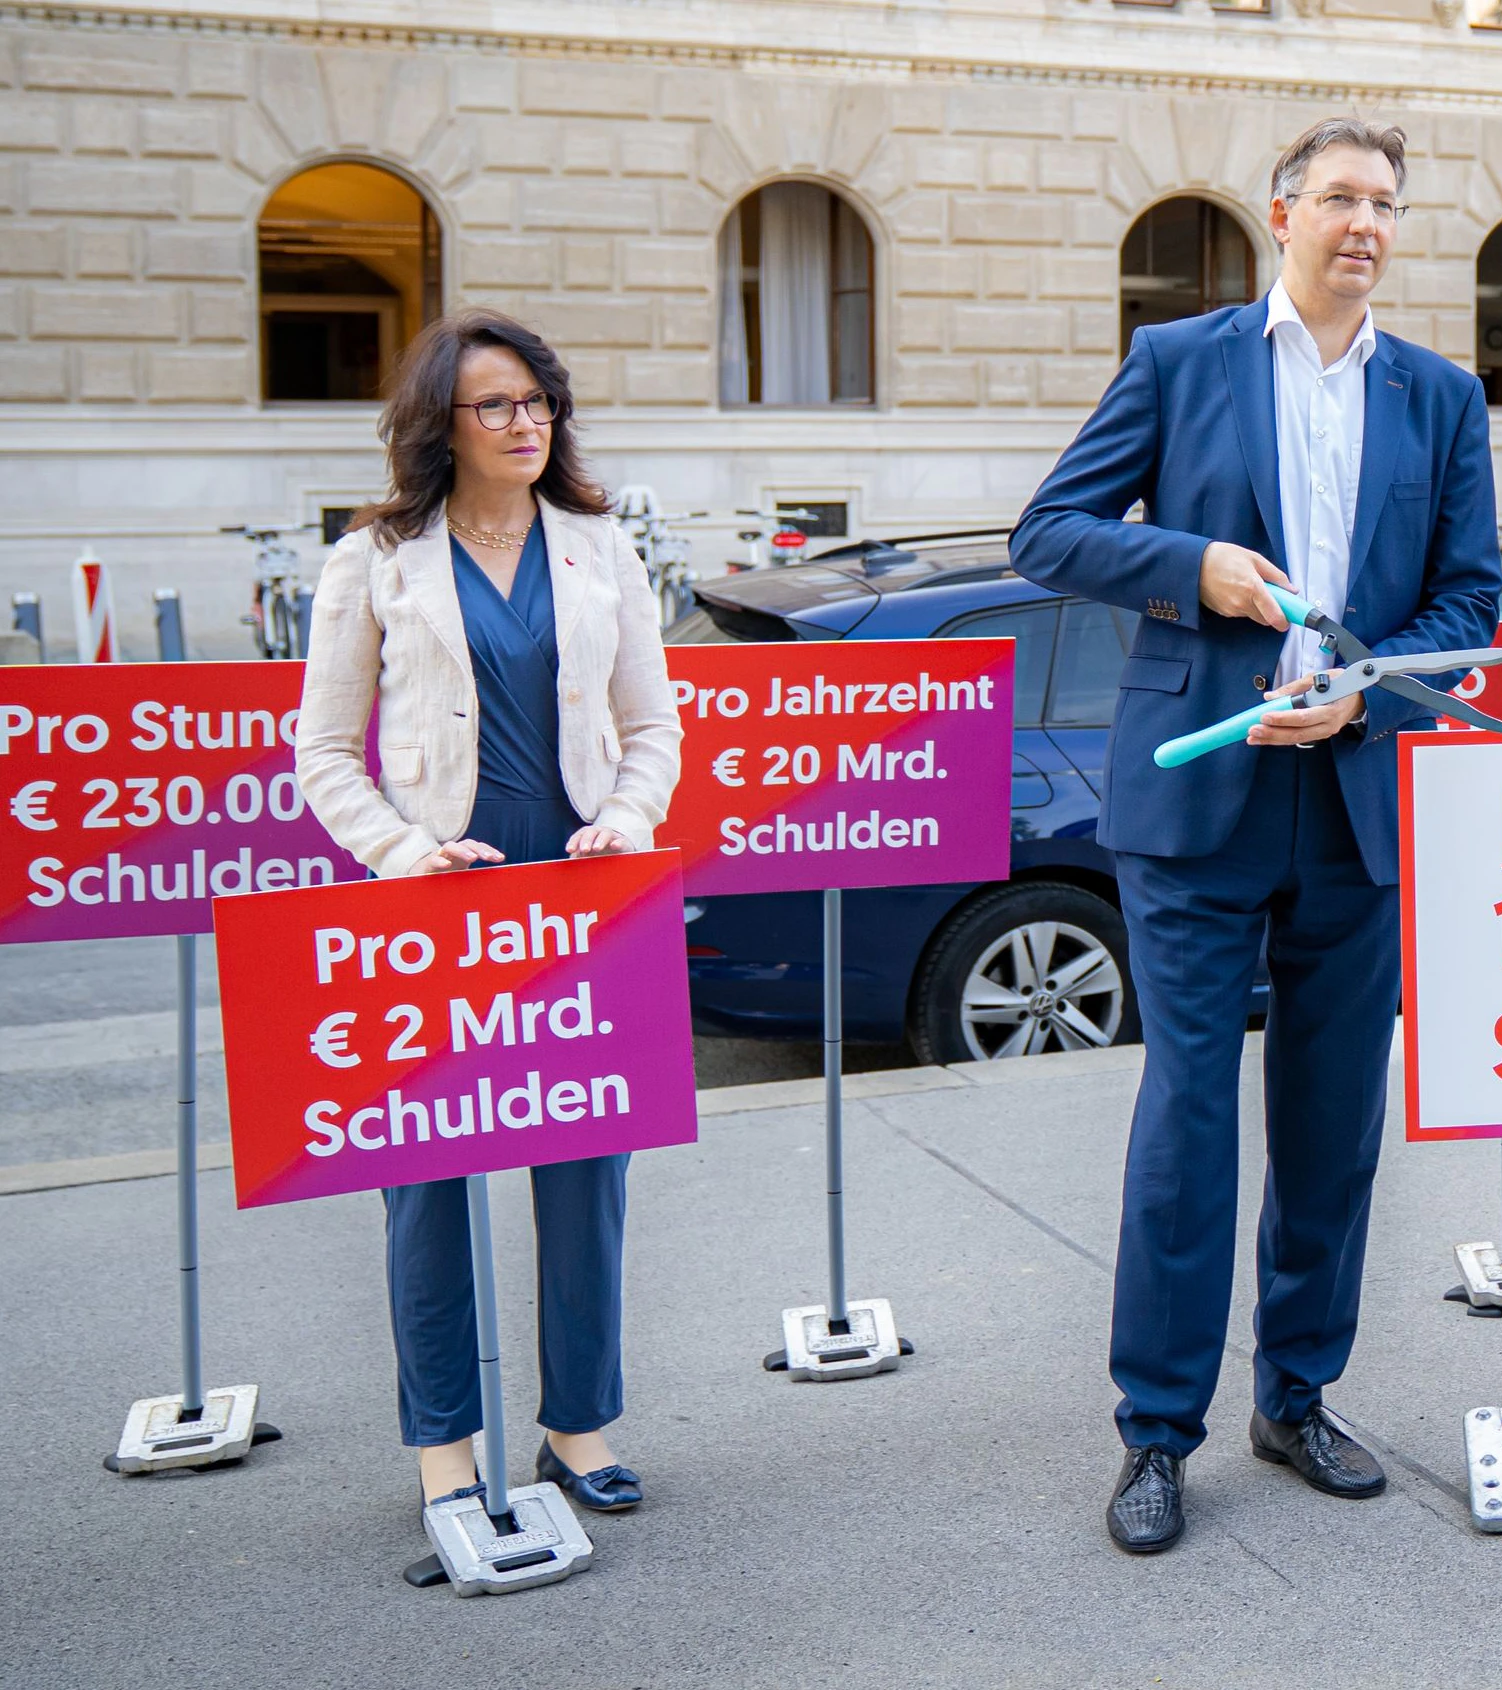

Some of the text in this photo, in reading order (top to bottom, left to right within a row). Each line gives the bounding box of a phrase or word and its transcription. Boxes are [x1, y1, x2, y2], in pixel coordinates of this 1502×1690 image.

[669, 672, 994, 718] Pro Jahrzehnt
[0, 704, 110, 755] Pro
[712, 740, 948, 787] € 20 Mrd.
[10, 780, 58, 831] €
[719, 810, 939, 856] Schulden
[27, 846, 334, 907] Schulden
[314, 903, 597, 984] Pro Jahr
[309, 981, 614, 1068] € 2 Mrd.
[304, 1070, 630, 1157] Schulden
